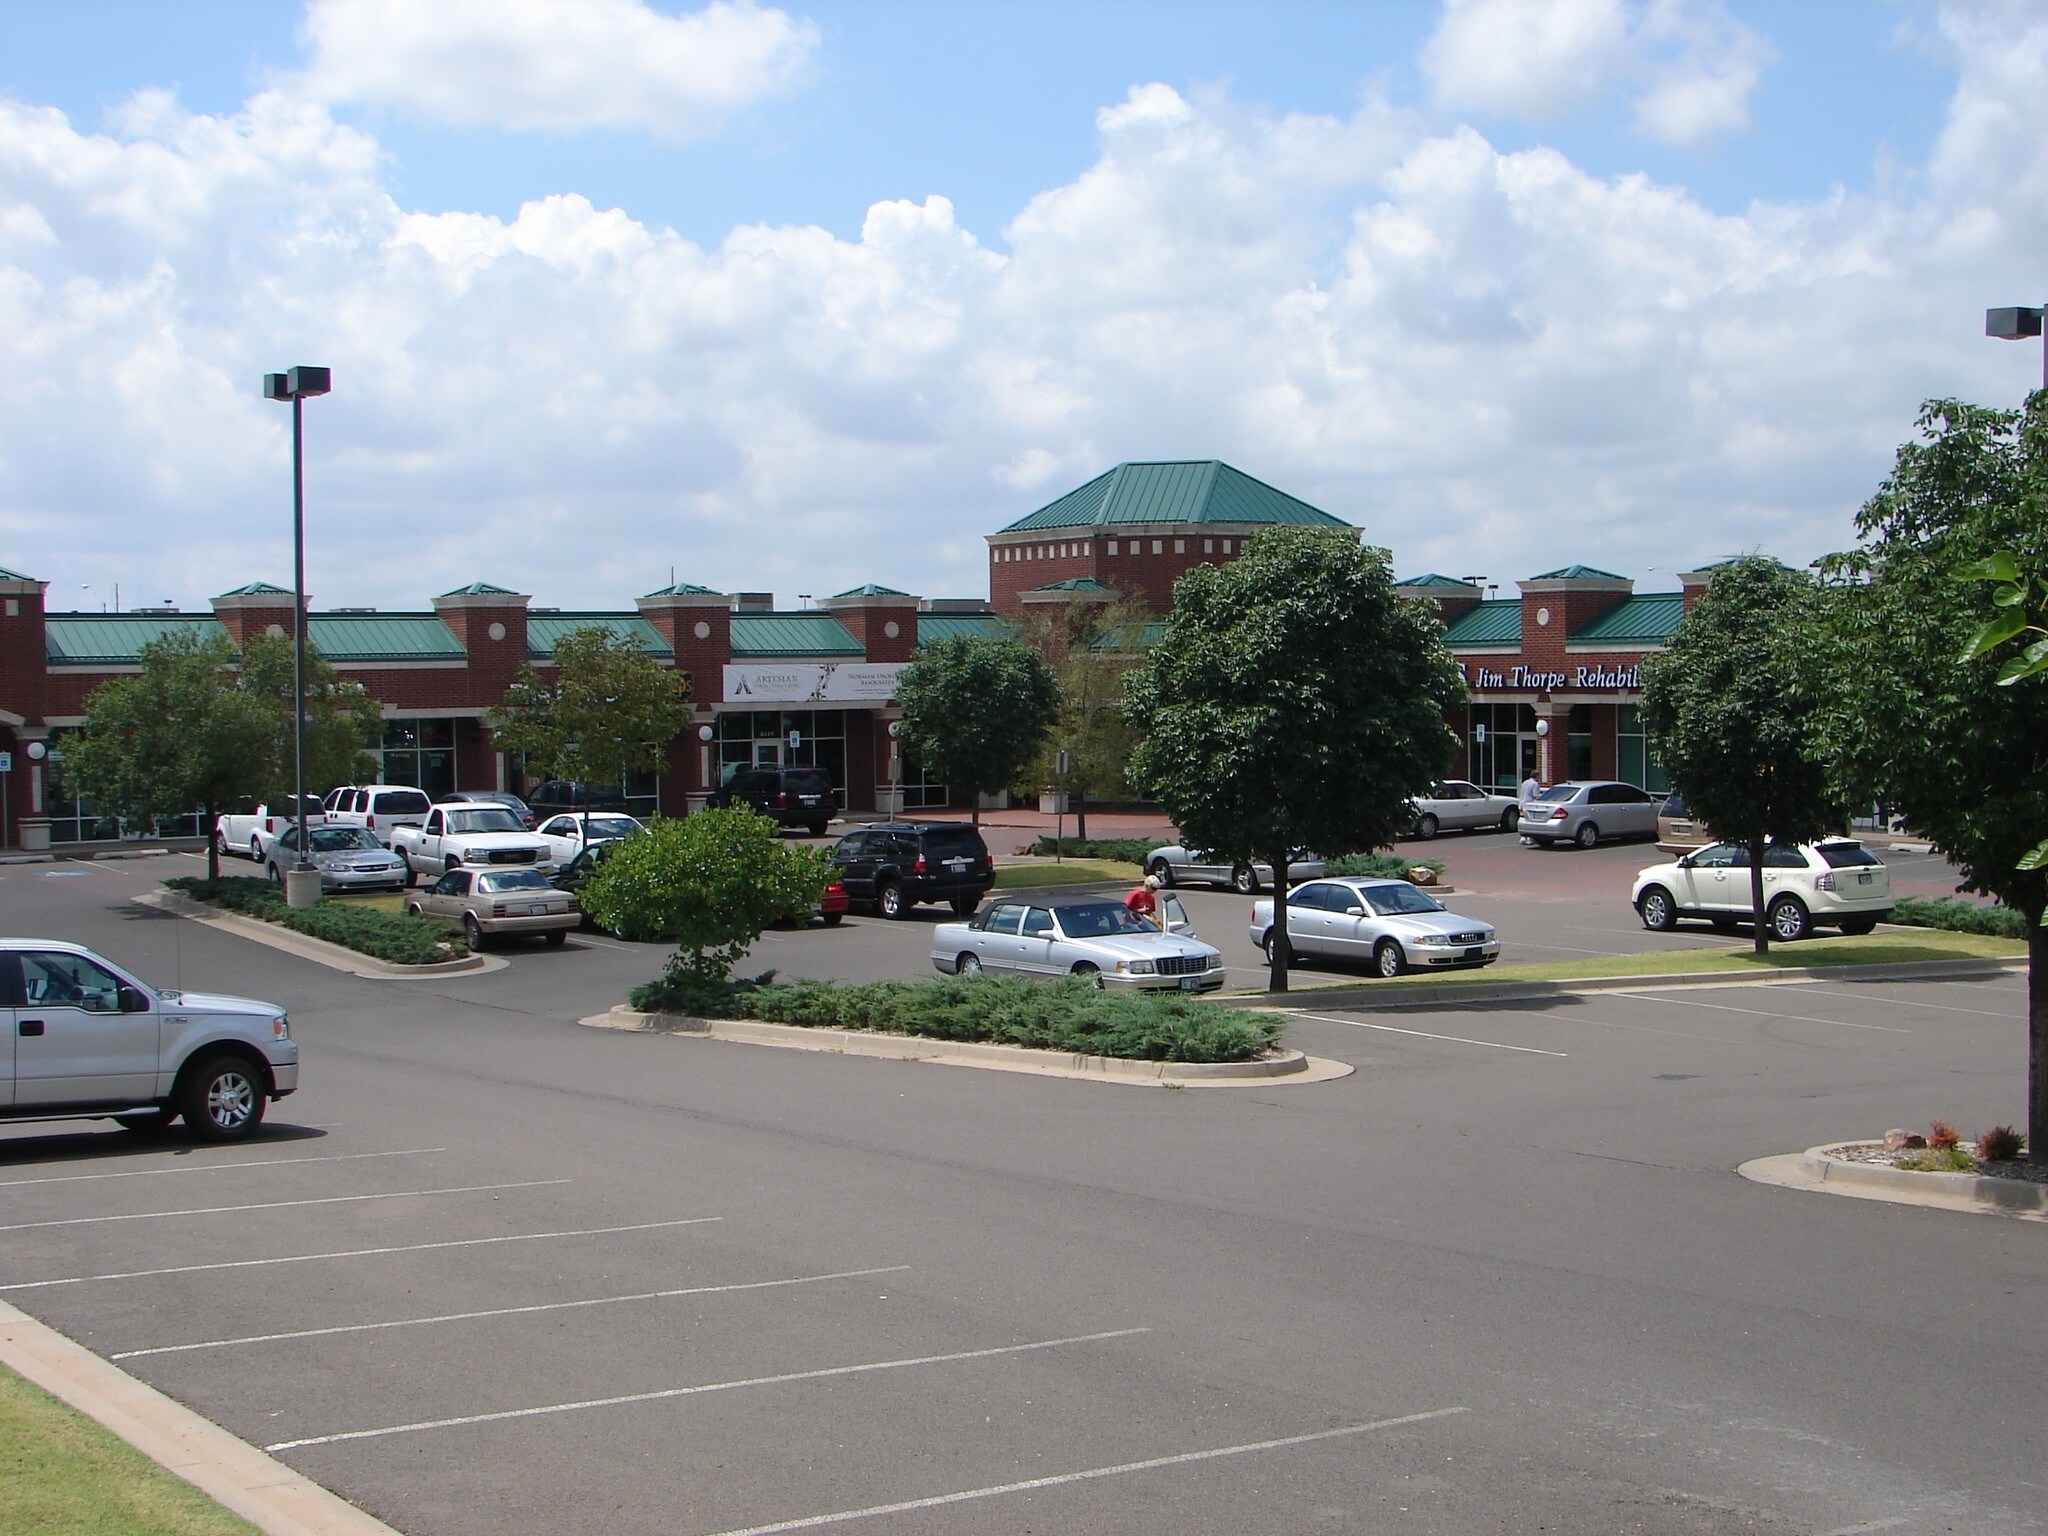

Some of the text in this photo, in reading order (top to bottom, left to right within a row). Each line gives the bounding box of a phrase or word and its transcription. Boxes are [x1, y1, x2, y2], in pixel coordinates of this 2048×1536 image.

[756, 675, 798, 683] ARTESIAN
[1475, 667, 1503, 688] Jim
[1511, 664, 1565, 693] Thorpe
[1575, 664, 1642, 688] Rehabil
